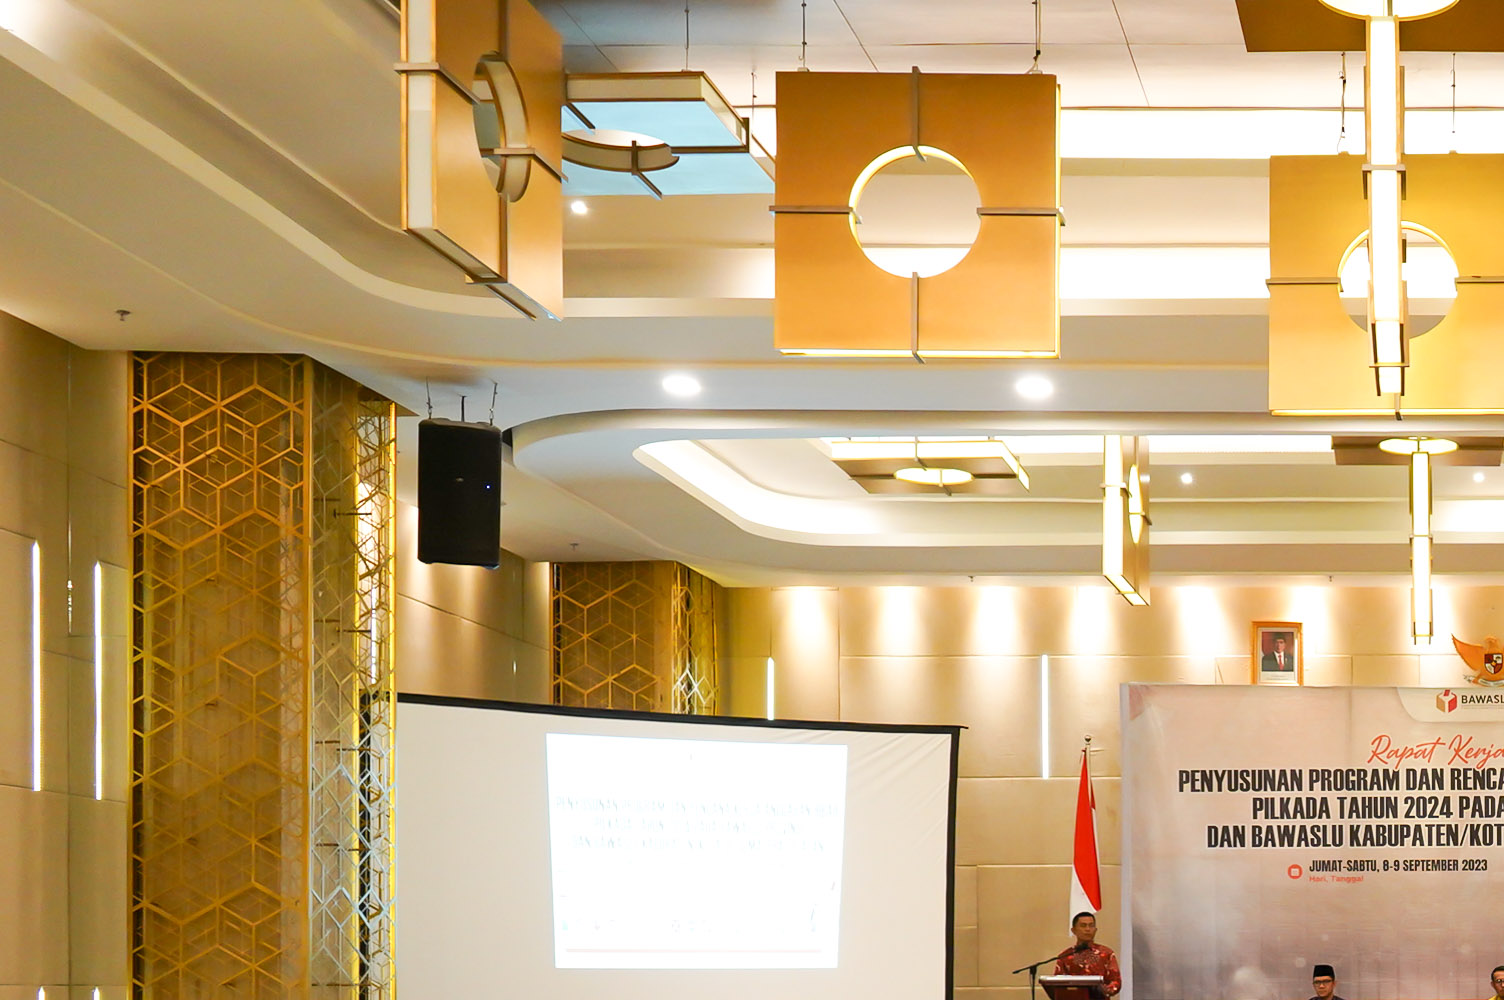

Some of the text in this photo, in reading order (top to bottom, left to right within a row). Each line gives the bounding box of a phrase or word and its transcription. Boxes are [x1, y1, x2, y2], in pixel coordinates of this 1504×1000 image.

[1367, 734, 1446, 769] Rapat
[1178, 769, 1303, 792] PENYUSUNAN
[1308, 768, 1400, 791] PROGRAM
[1405, 767, 1445, 791] DAN
[1252, 797, 1331, 820] PILKADA
[1336, 796, 1398, 819] TAHUN
[1403, 796, 1454, 819] 2024
[1207, 825, 1246, 848] DAN
[1251, 824, 1344, 848] BAWASLU
[1309, 859, 1488, 873] JUMAT-SABTU, 8-9 SEPTEMBER 2023
